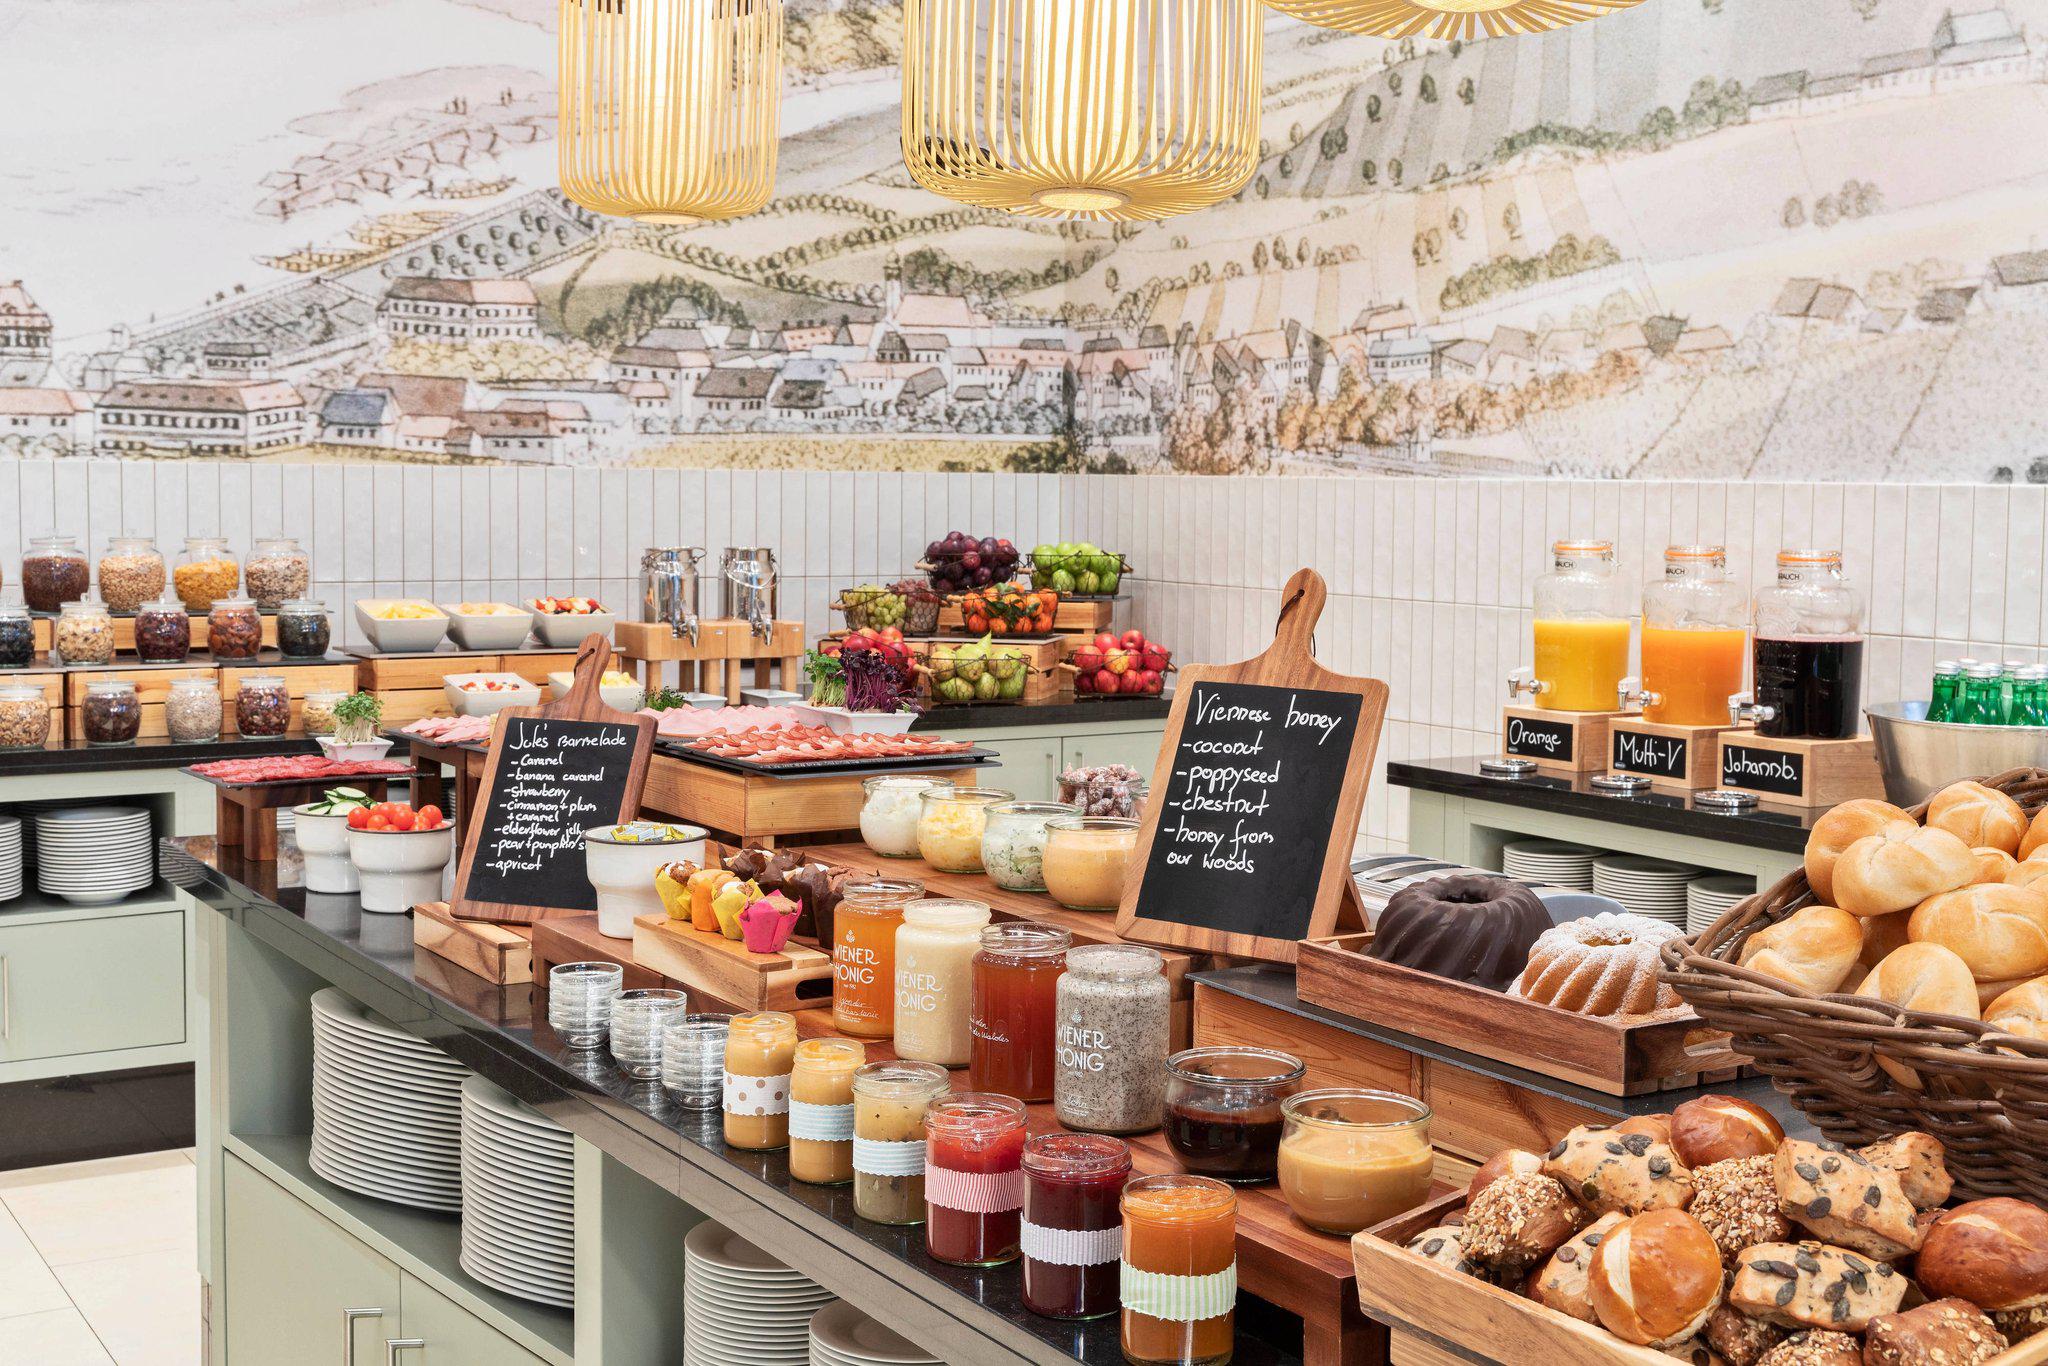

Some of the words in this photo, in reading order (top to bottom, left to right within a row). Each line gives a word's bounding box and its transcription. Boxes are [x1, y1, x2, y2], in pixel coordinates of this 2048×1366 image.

[1195, 690, 1271, 725] Viennese
[1285, 694, 1342, 745] honey
[1508, 719, 1562, 752] Orange
[1618, 734, 1683, 771] Multi-V
[1724, 747, 1798, 780] Johannb.
[563, 766, 605, 782] caramel
[565, 822, 586, 844] jelly
[1230, 818, 1274, 859] from
[1167, 852, 1193, 865] our
[1203, 850, 1255, 873] woods
